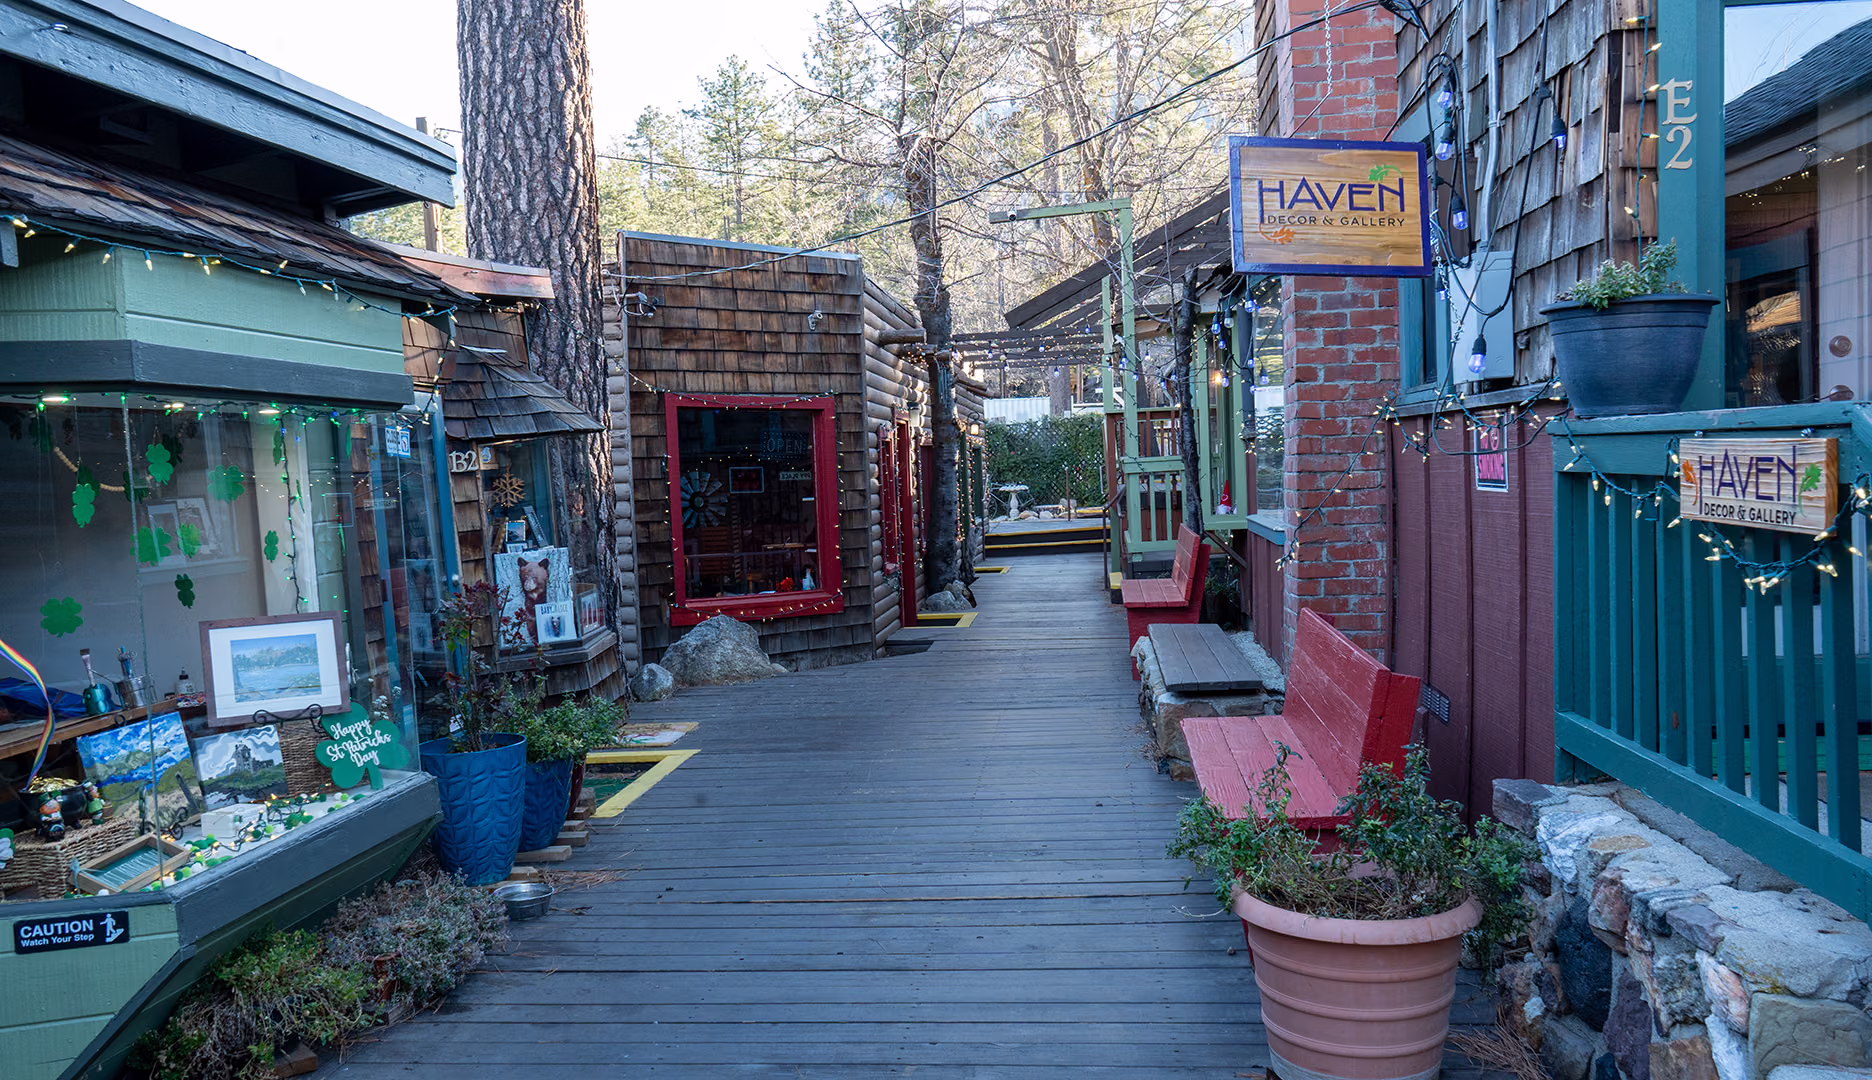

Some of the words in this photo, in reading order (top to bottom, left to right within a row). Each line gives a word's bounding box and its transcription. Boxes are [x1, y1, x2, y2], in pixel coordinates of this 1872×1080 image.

[1258, 176, 1405, 224] HAVEN
[1267, 214, 1317, 225] DECOR
[1322, 214, 1335, 226] &
[1340, 216, 1405, 227] GALLERY
[767, 438, 802, 454] OPEN
[449, 450, 479, 473] B2
[1698, 445, 1797, 515] HAVEN
[1704, 502, 1735, 518] DECOR
[1737, 504, 1746, 520] &
[1749, 507, 1797, 525] GALLERY
[330, 719, 372, 740] Happy
[326, 744, 345, 762] St
[350, 750, 380, 767] Day
[20, 919, 94, 938] CAUTION
[20, 939, 49, 947] Watch
[51, 936, 72, 944] Your
[74, 933, 95, 942] Step
